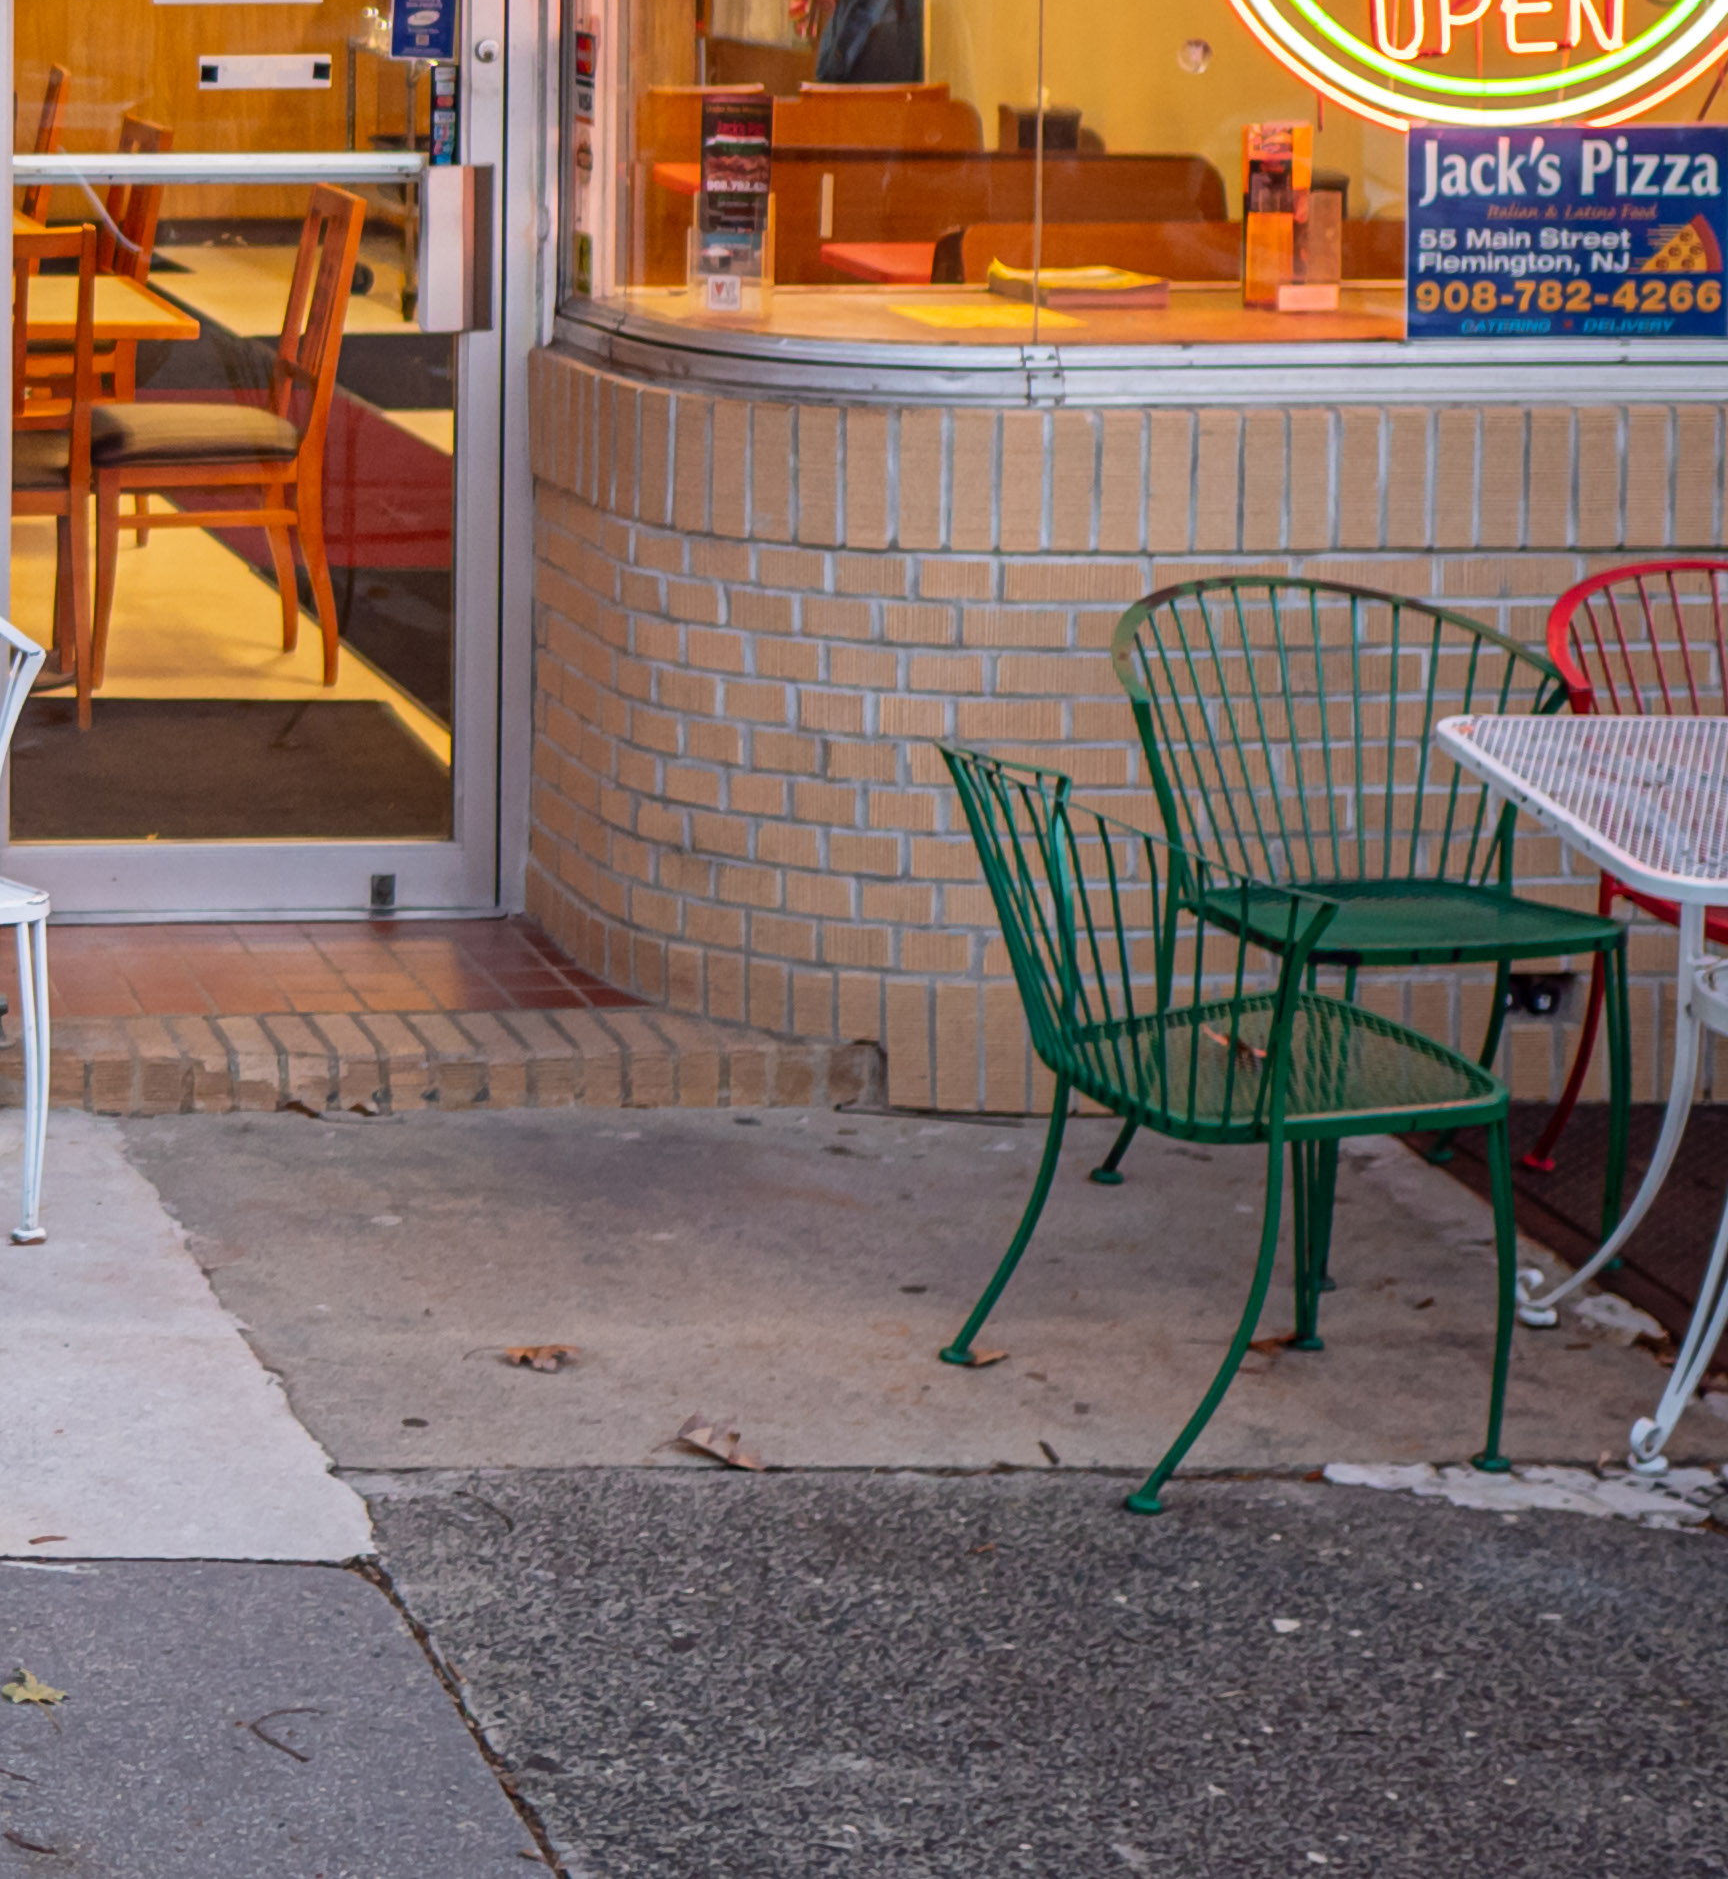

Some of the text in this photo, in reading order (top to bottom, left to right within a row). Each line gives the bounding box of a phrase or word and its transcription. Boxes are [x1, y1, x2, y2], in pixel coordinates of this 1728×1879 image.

[1418, 135, 1722, 208] Jack's Pizza
[1486, 204, 1539, 221] Italian
[1620, 202, 1658, 220] Food
[1418, 227, 1631, 250] 55 Main Street
[1418, 251, 1630, 278] Flemington, NJ
[1415, 278, 1722, 314] 908-782-4266
[1460, 317, 1675, 334] CATERING DELIVERY
